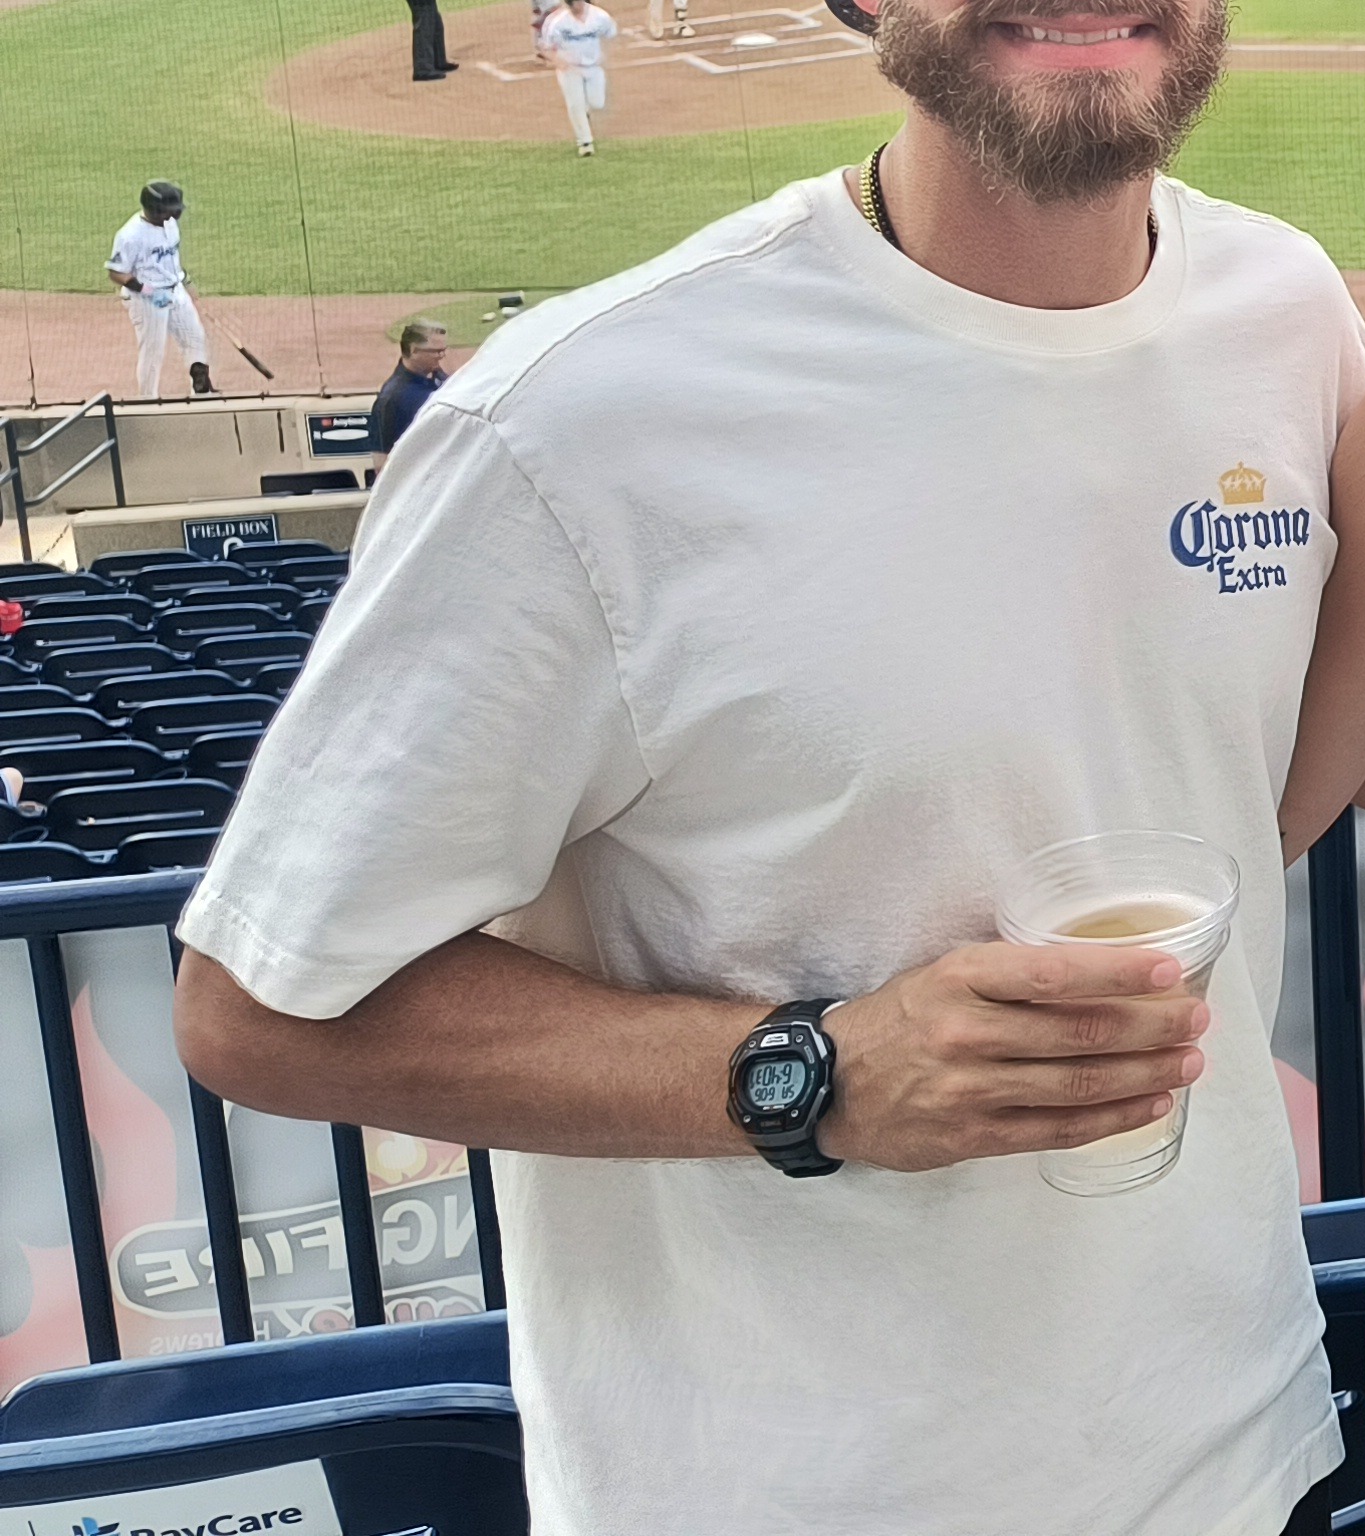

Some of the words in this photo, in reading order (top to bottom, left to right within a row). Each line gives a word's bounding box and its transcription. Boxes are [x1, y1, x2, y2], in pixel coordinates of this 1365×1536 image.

[192, 523, 236, 539] FIELD
[240, 520, 269, 536] BOX
[1169, 498, 1310, 573] Corona
[1216, 555, 1288, 595] Extra
